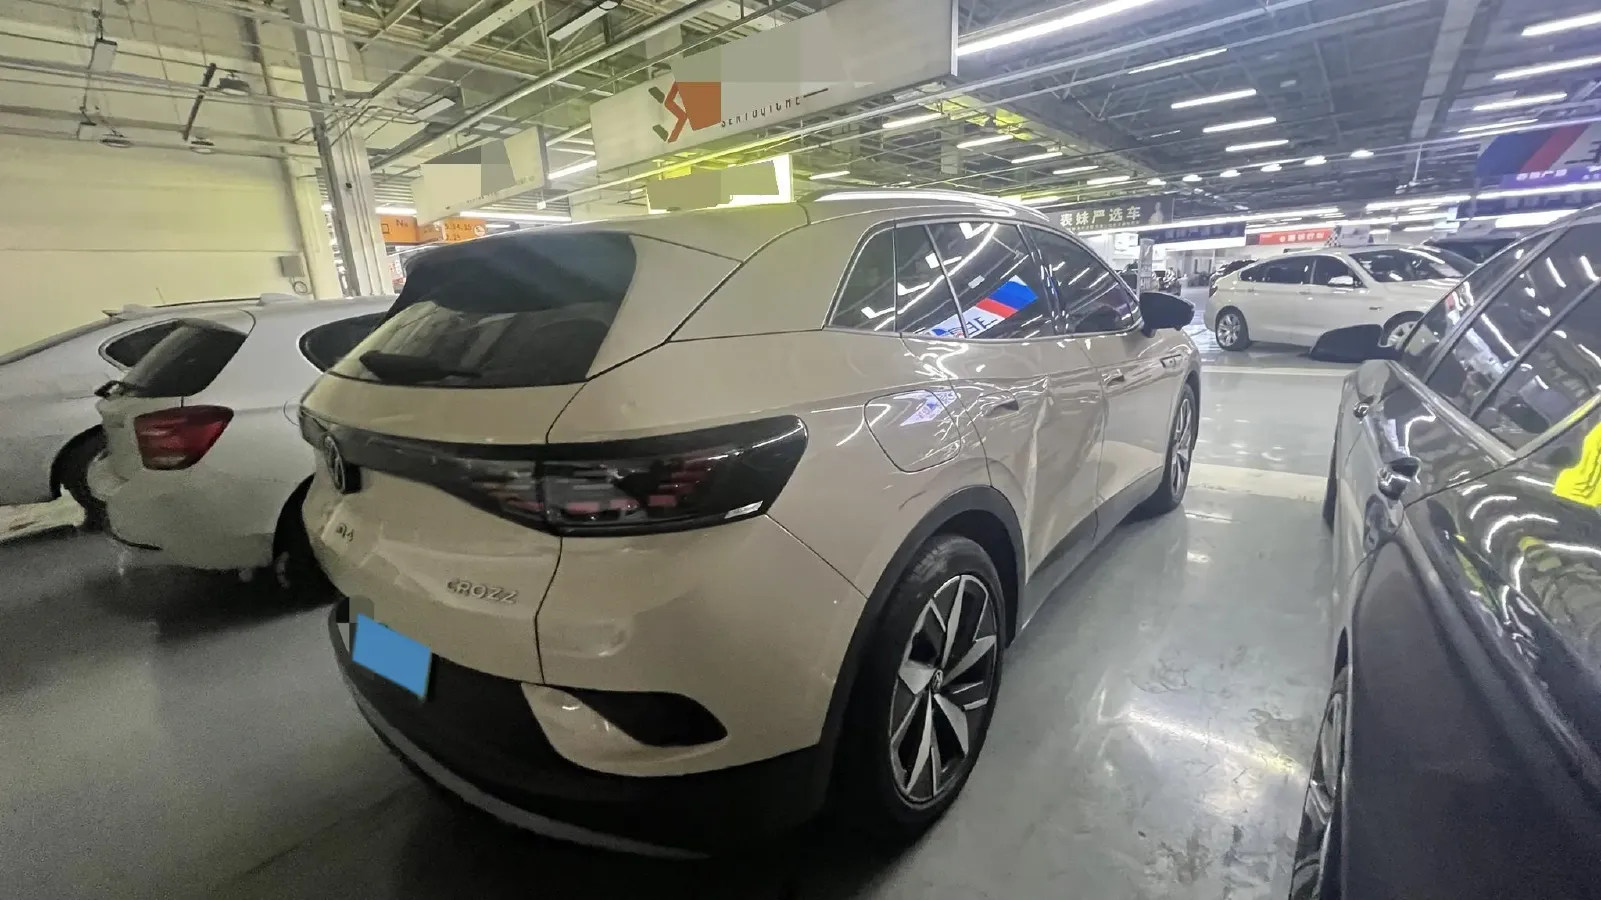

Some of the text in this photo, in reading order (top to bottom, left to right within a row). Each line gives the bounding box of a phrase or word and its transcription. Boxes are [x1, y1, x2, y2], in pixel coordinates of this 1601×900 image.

[1060, 205, 1141, 226] 表妹严选车
[447, 577, 518, 604] CROZZ
